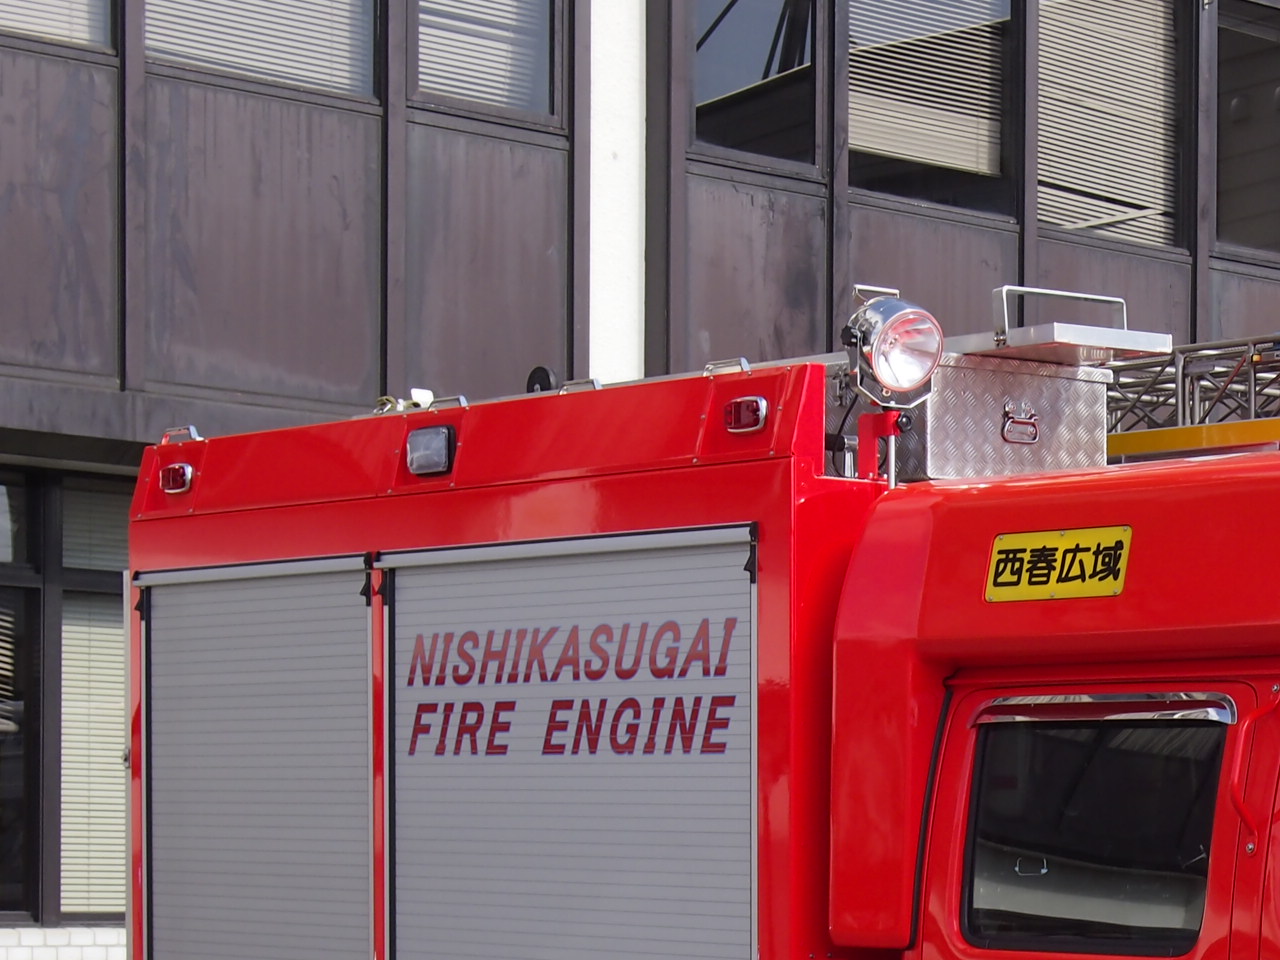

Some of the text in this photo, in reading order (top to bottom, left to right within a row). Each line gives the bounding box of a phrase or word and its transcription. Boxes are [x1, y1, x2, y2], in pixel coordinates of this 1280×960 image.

[992, 540, 1124, 588] 西春広域
[407, 617, 738, 687] NISHIKASUGAI
[408, 695, 737, 756] FIRE ENGINE
